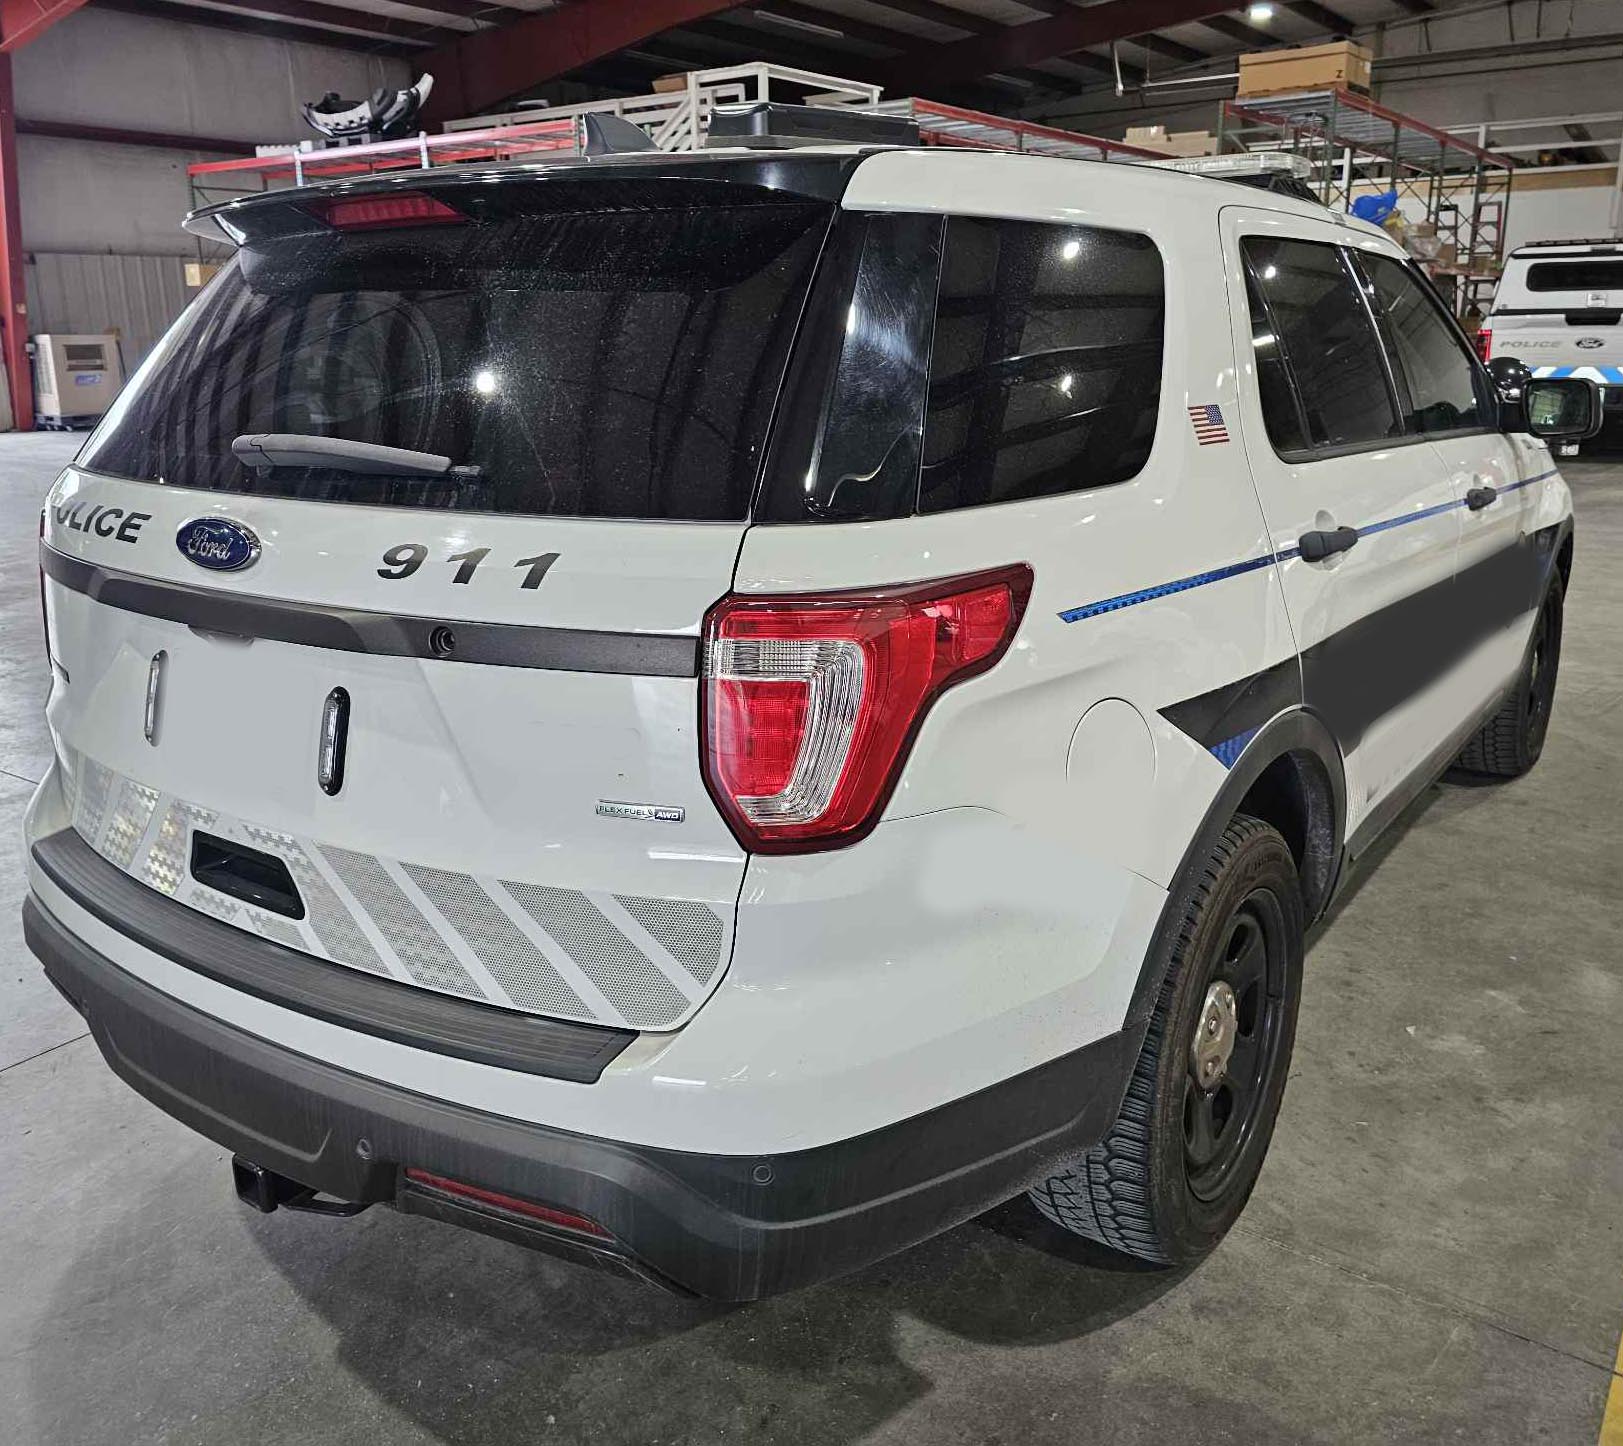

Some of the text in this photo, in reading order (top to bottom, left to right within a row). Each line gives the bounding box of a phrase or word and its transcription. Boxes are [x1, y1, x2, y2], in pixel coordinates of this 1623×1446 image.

[1500, 341, 1560, 349] POLICE
[52, 501, 152, 544] OLICE
[187, 525, 234, 561] Ford
[376, 543, 562, 590] 911
[599, 805, 679, 820] FLEX FUEL AWD
